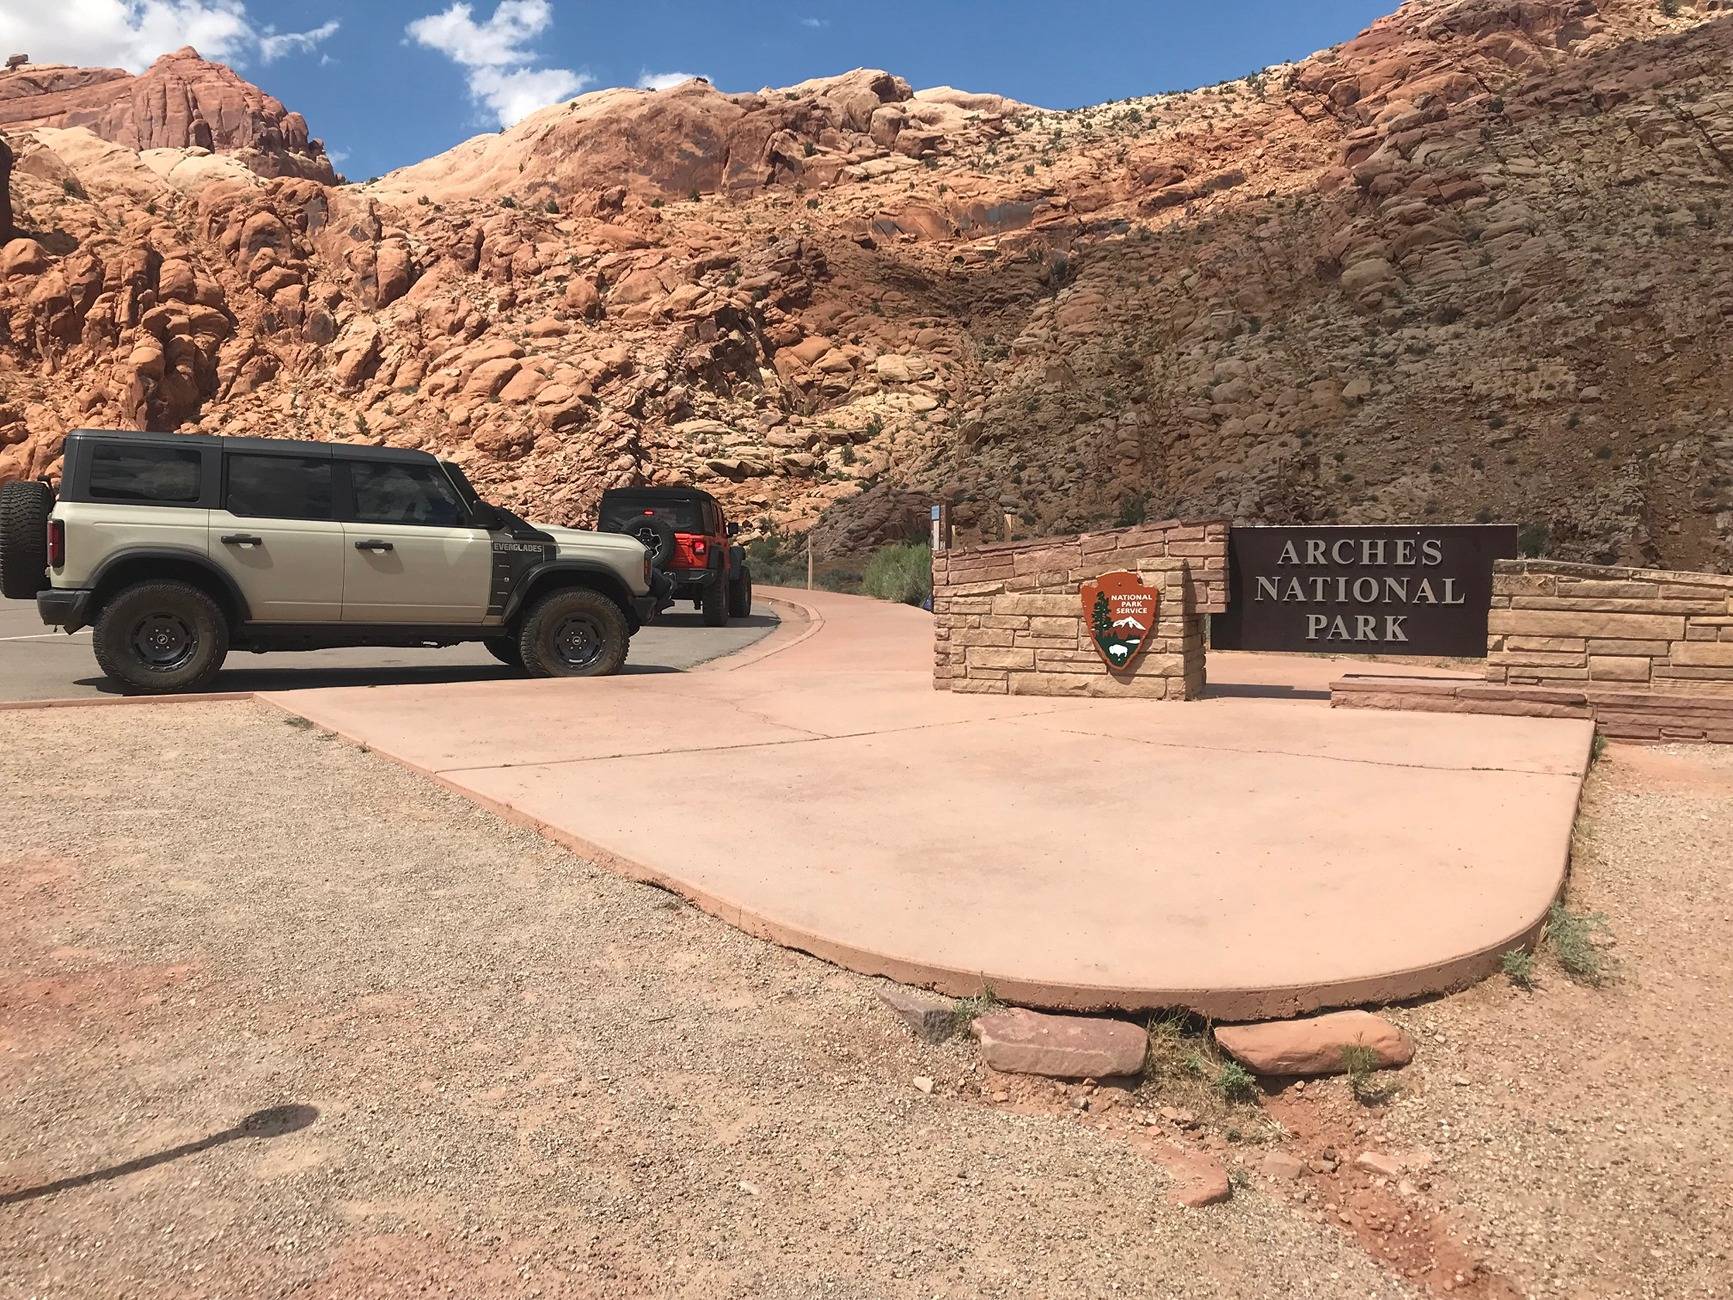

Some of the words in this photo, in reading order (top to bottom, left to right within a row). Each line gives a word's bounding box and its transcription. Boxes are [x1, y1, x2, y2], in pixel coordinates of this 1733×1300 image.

[494, 543, 542, 552] EVERGLADES
[1277, 539, 1443, 566] ARCHES
[1254, 576, 1466, 604] NATIONAL
[1305, 614, 1409, 642] PARK
